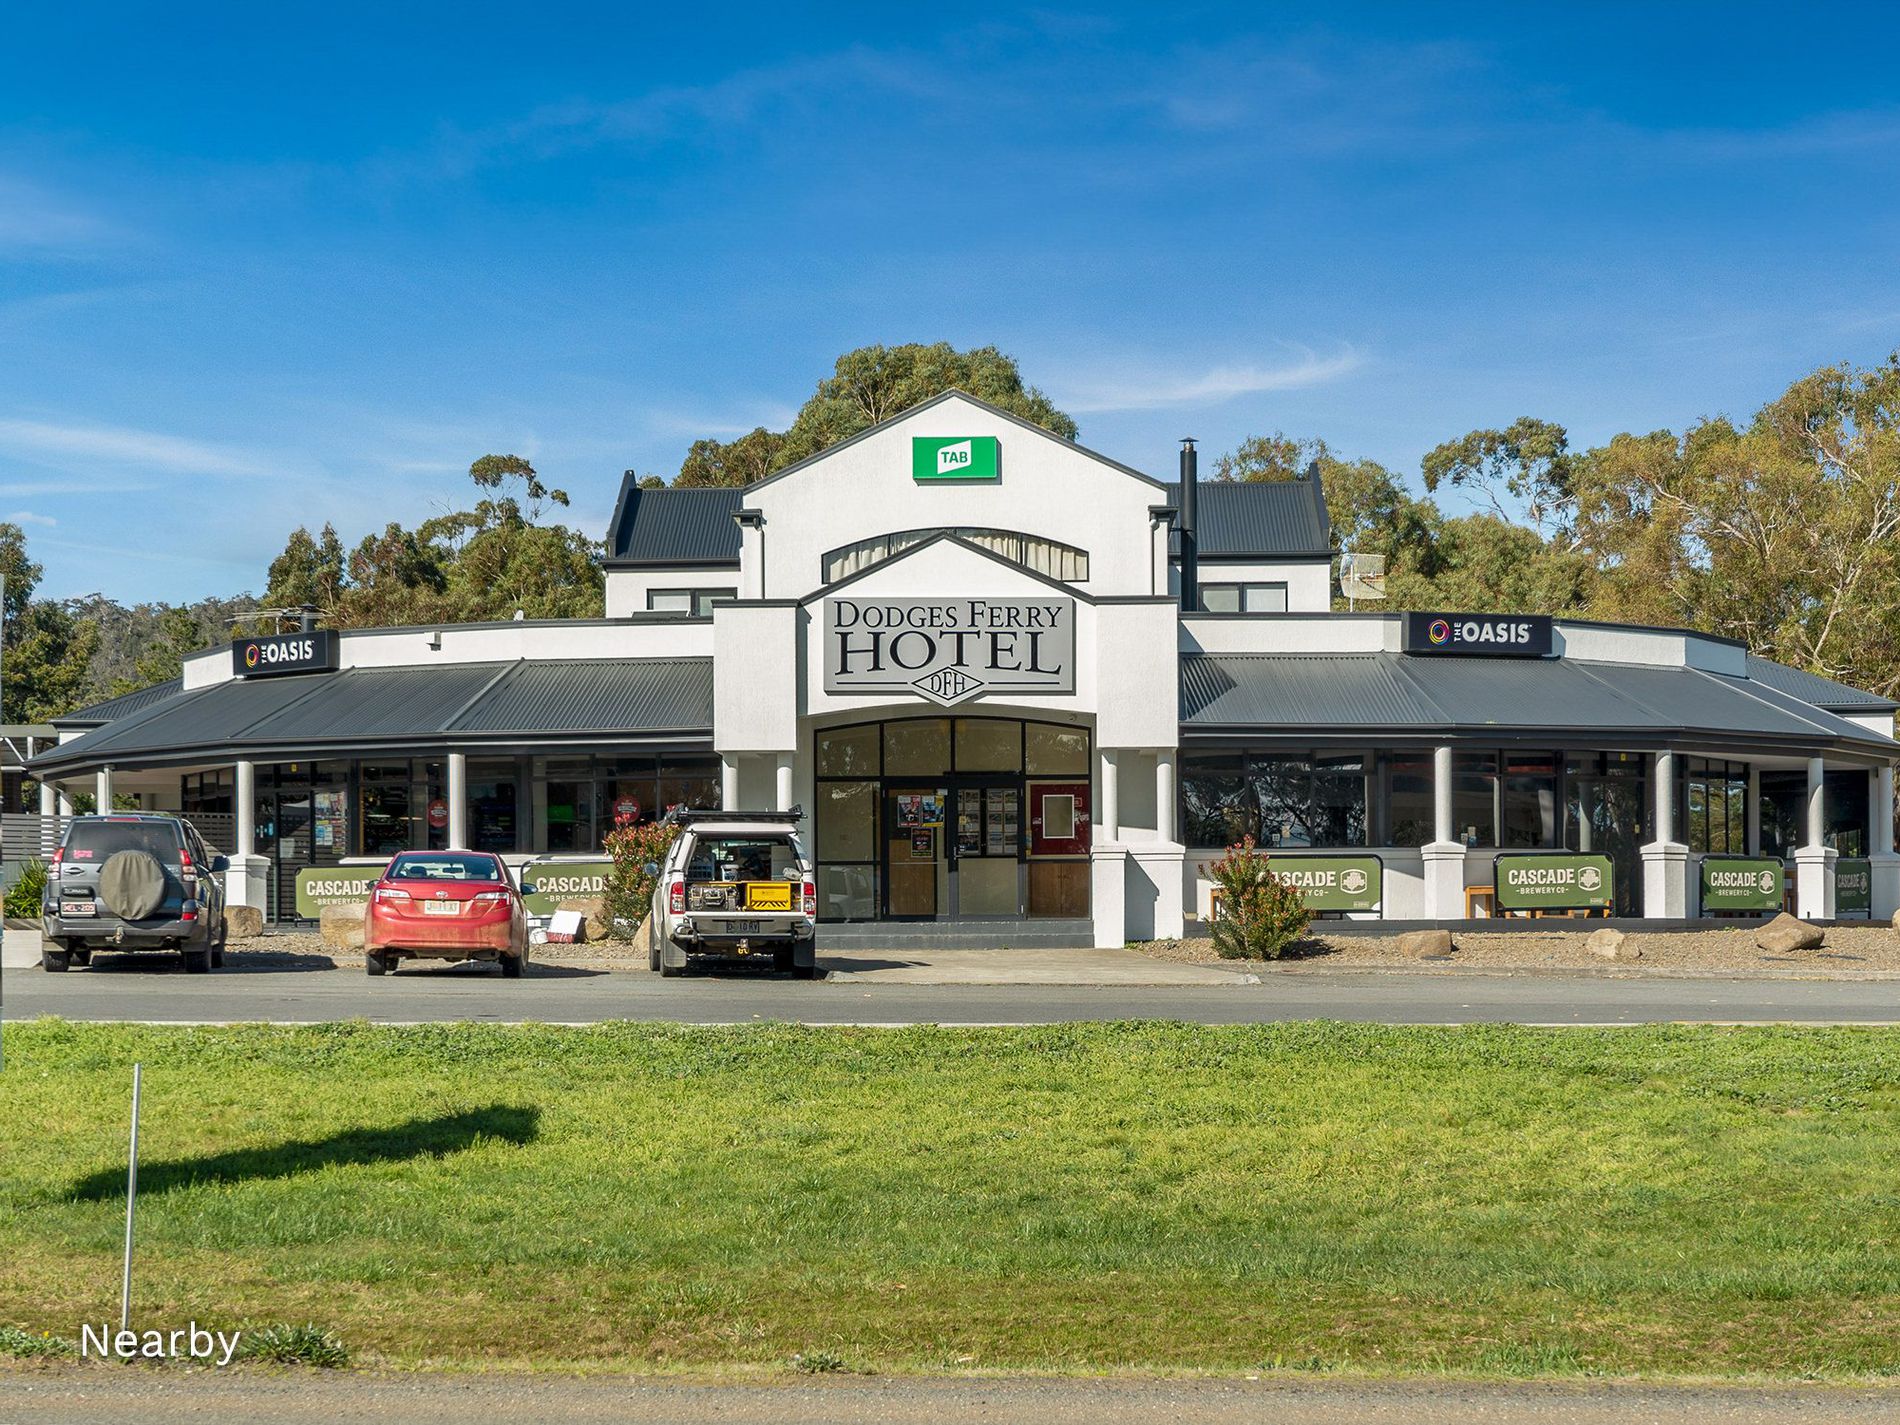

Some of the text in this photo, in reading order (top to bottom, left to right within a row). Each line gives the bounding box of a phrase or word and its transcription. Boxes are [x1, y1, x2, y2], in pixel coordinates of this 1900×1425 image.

[941, 451, 968, 463] TAB
[834, 601, 1062, 628] DODGES FERRY
[1462, 621, 1530, 643] OASIS
[267, 640, 313, 663] OASIS
[835, 630, 1062, 675] HOTEL
[930, 671, 966, 695] DFH
[536, 876, 612, 893] CASCAD
[1508, 868, 1575, 885] CASCADE
[1710, 871, 1757, 887] CASCADE
[306, 880, 370, 896] CASCADE
